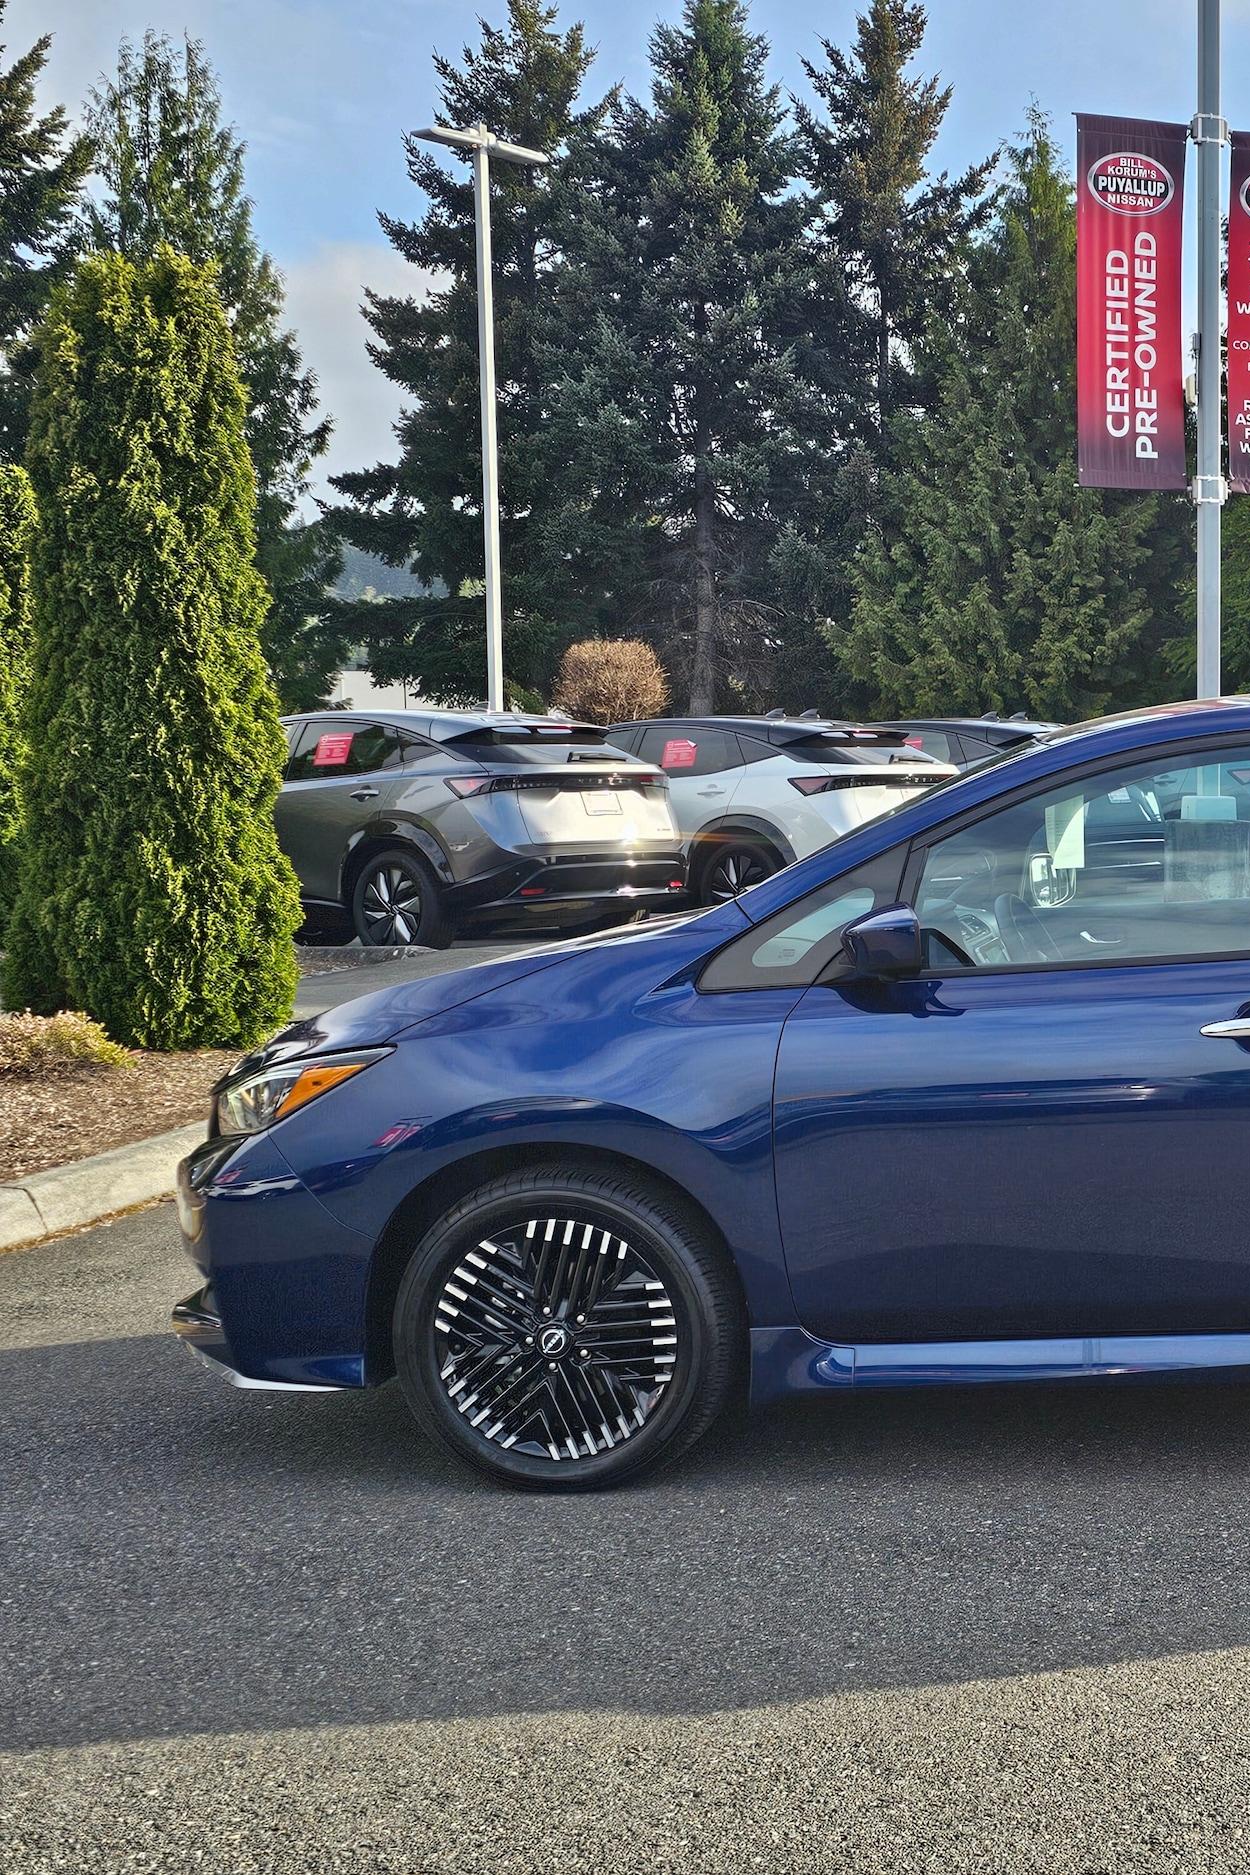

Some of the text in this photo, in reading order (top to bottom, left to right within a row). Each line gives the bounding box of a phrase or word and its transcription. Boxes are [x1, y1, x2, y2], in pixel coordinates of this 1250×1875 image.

[1120, 157, 1144, 168] BILL
[1107, 165, 1157, 179] KORUM'S
[1098, 175, 1166, 197] PUYALLUP
[1107, 193, 1154, 208] NISSAN
[1106, 249, 1130, 438] CERTIFIED
[1134, 231, 1159, 459] PRE-OWNED
